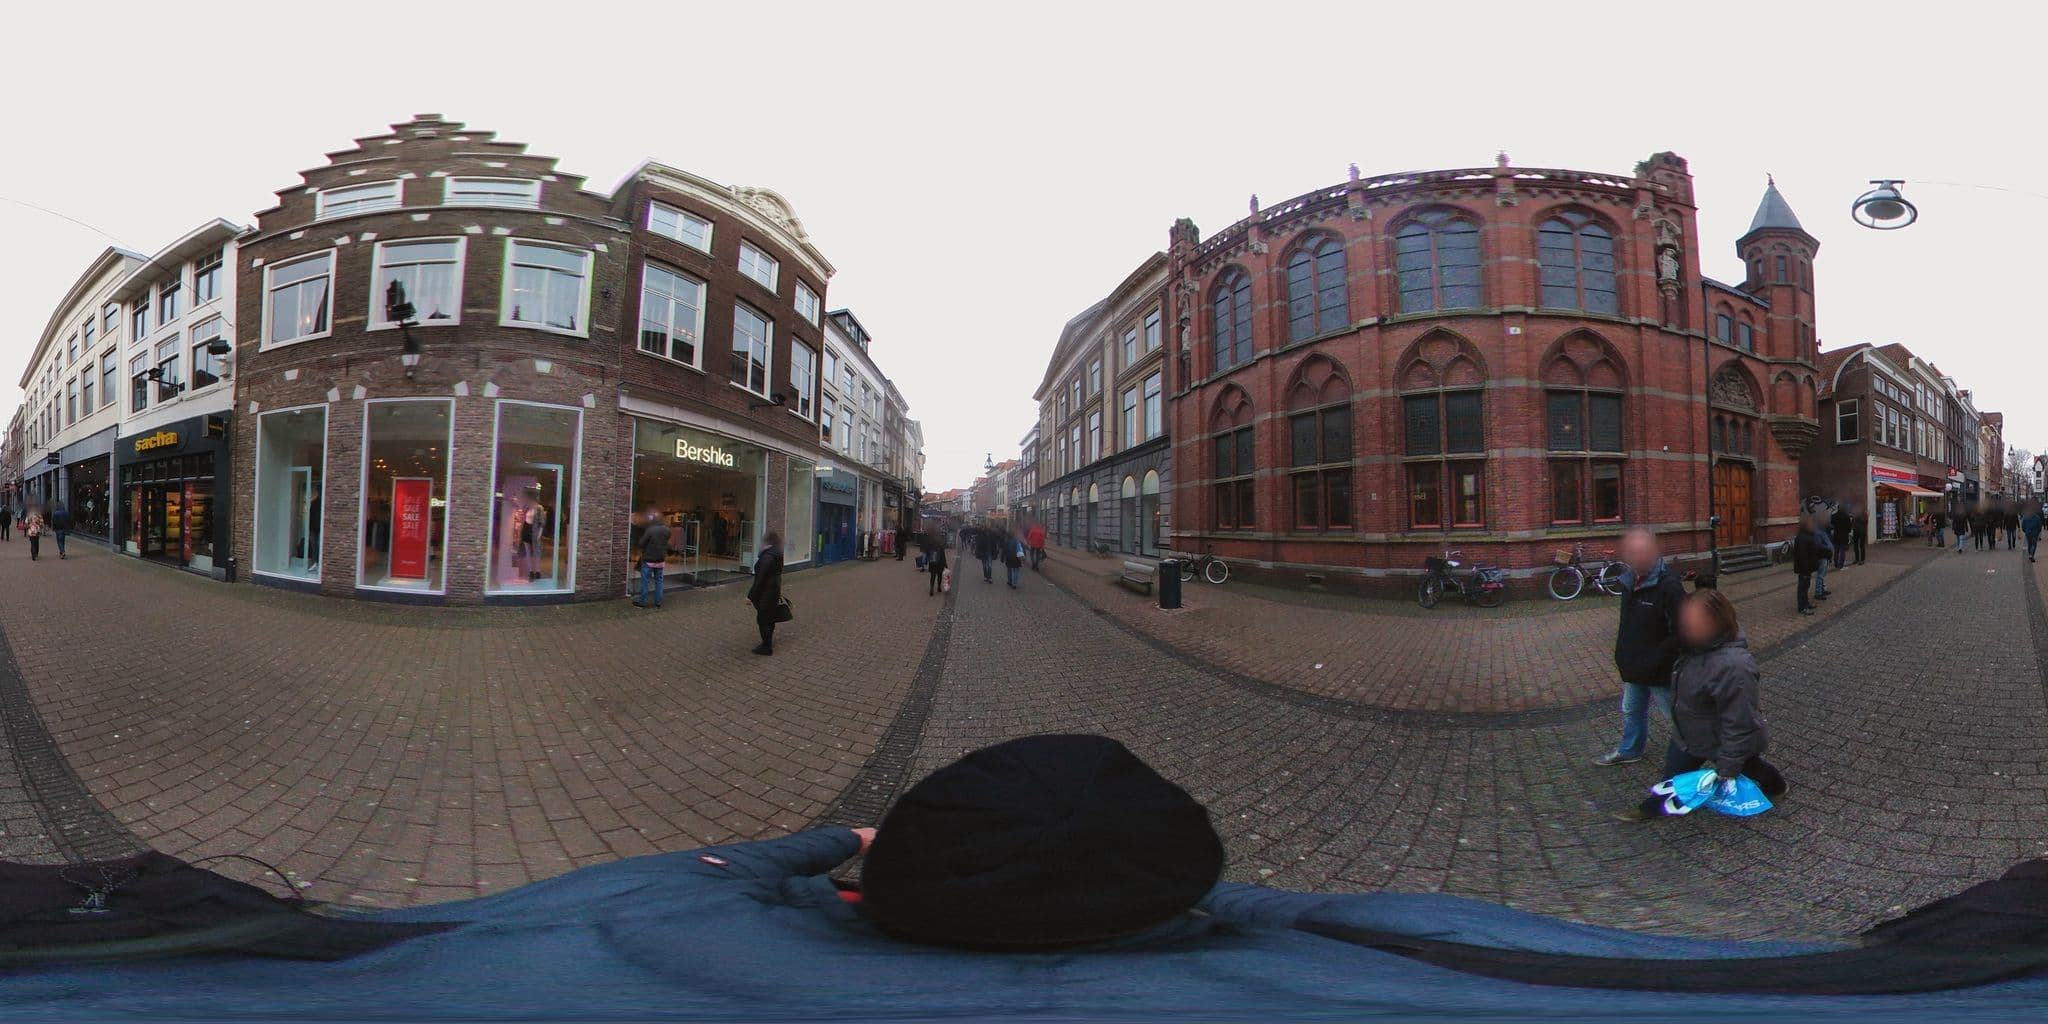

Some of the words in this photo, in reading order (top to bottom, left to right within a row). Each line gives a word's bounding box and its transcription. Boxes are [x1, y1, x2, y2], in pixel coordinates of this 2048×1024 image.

[135, 431, 178, 451] sacha
[676, 439, 733, 467] Bershka
[402, 513, 419, 521] SALE
